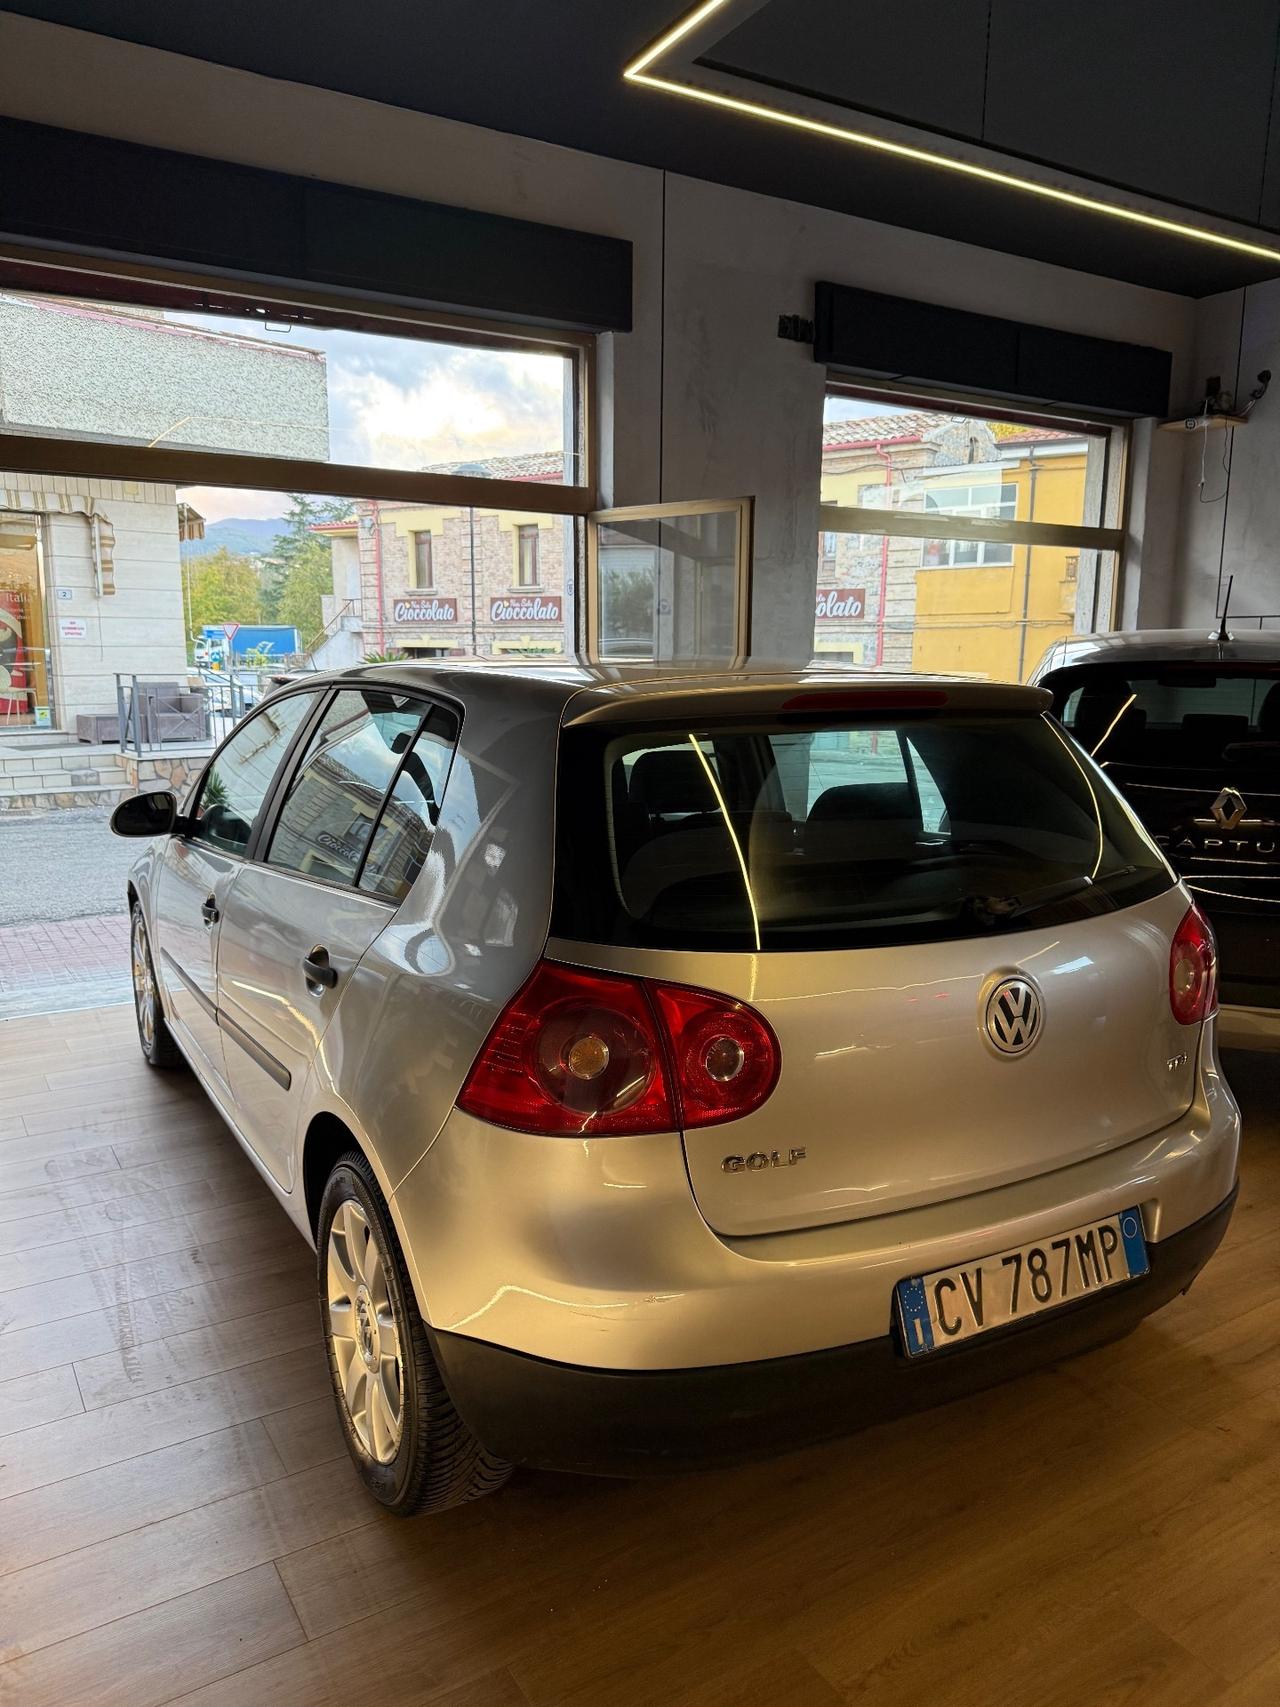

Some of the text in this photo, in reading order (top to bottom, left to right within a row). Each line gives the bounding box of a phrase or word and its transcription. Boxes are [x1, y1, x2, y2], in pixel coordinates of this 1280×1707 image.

[395, 600, 455, 621] Cioccolato
[491, 598, 559, 621] Cioccolato
[721, 1146, 807, 1174] GOLF
[933, 1267, 984, 1336] CV
[1002, 1224, 1119, 1316] 787MP
